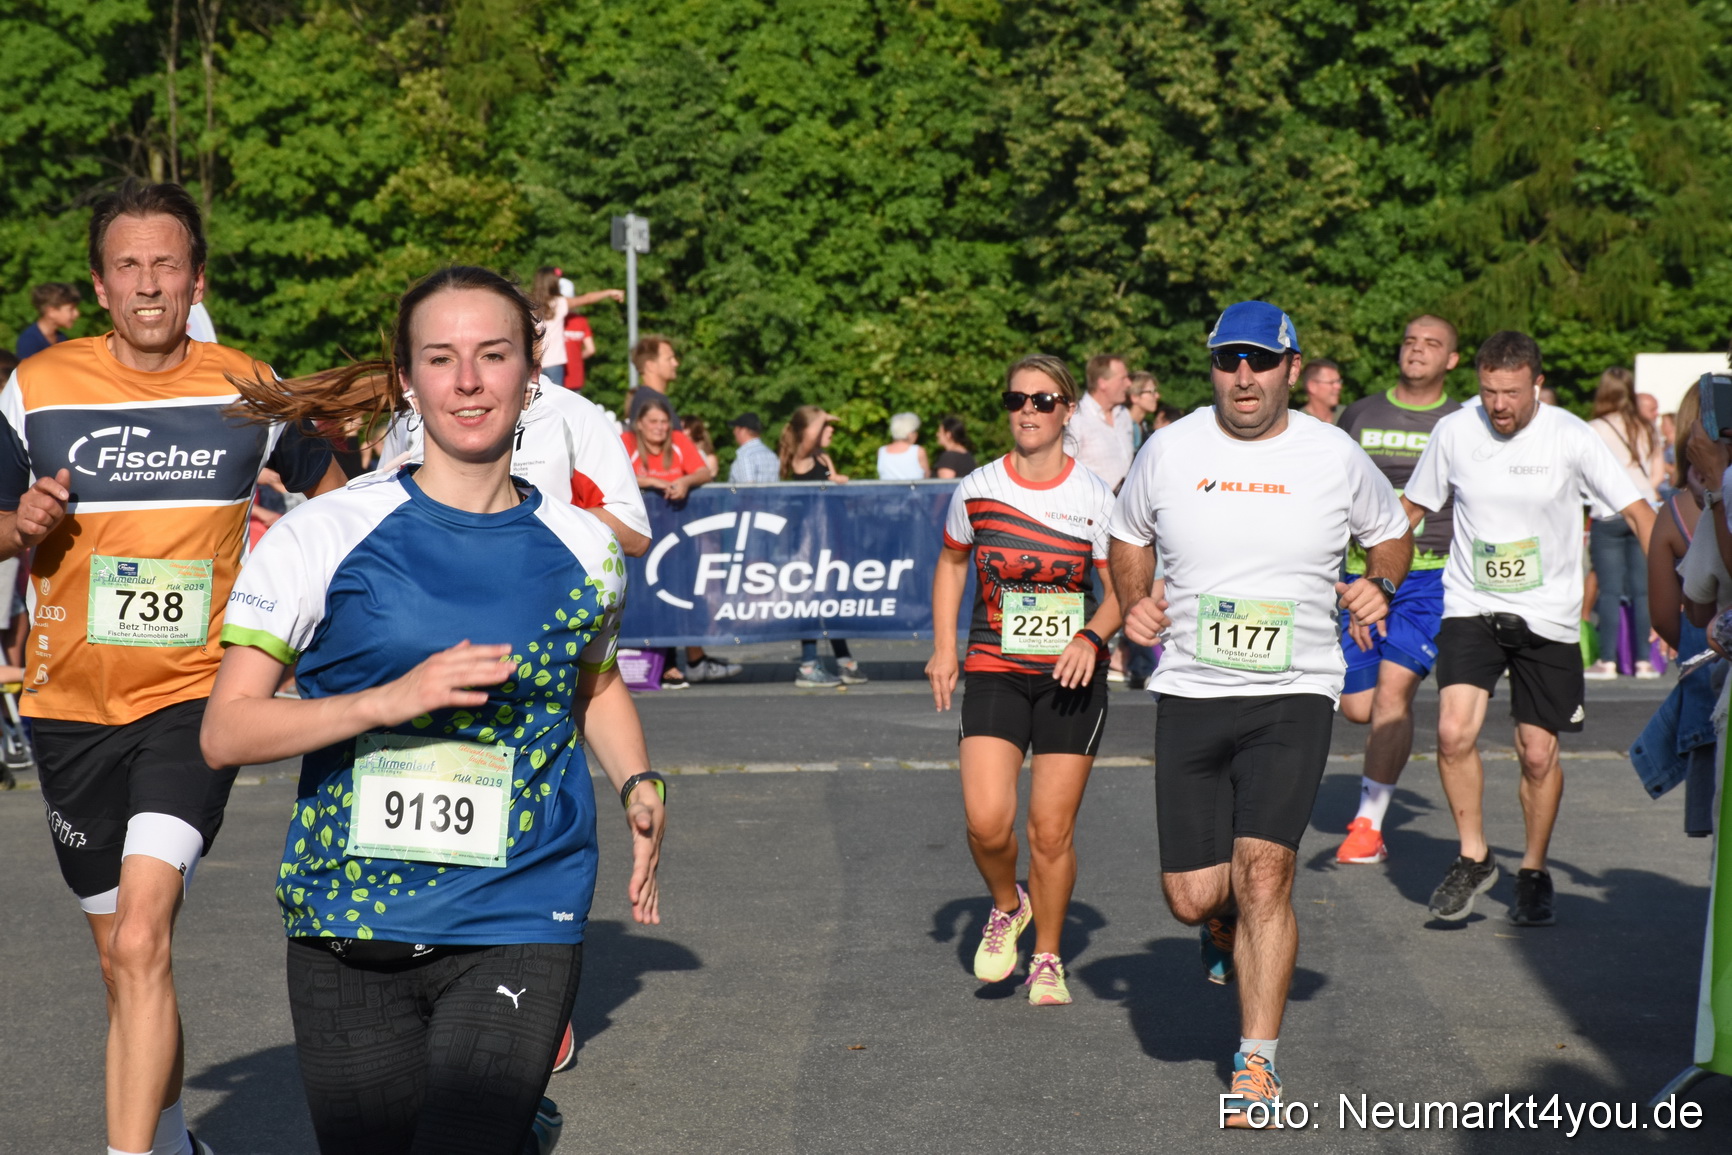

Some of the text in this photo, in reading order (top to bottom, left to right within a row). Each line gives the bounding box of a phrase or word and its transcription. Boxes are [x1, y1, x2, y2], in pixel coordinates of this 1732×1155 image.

[97, 444, 226, 469] Fischer
[109, 469, 216, 482] AUTOMOBILE
[1509, 465, 1549, 475] ROBERT
[1221, 482, 1291, 494] KLEBL
[1045, 511, 1086, 524] NEUMARKT
[694, 549, 914, 596] Fischer
[1486, 559, 1526, 578] 652
[108, 574, 156, 585] firmenlauf
[116, 590, 184, 622] 738
[714, 598, 896, 621] AUTOMOBILE
[119, 622, 179, 632] Betz Thomas
[1013, 615, 1070, 636] 2251
[1210, 622, 1280, 651] 1177
[1250, 651, 1270, 659] Josef
[378, 757, 436, 770] firmenlauf
[475, 776, 503, 788] 2019
[384, 790, 474, 835] 9139
